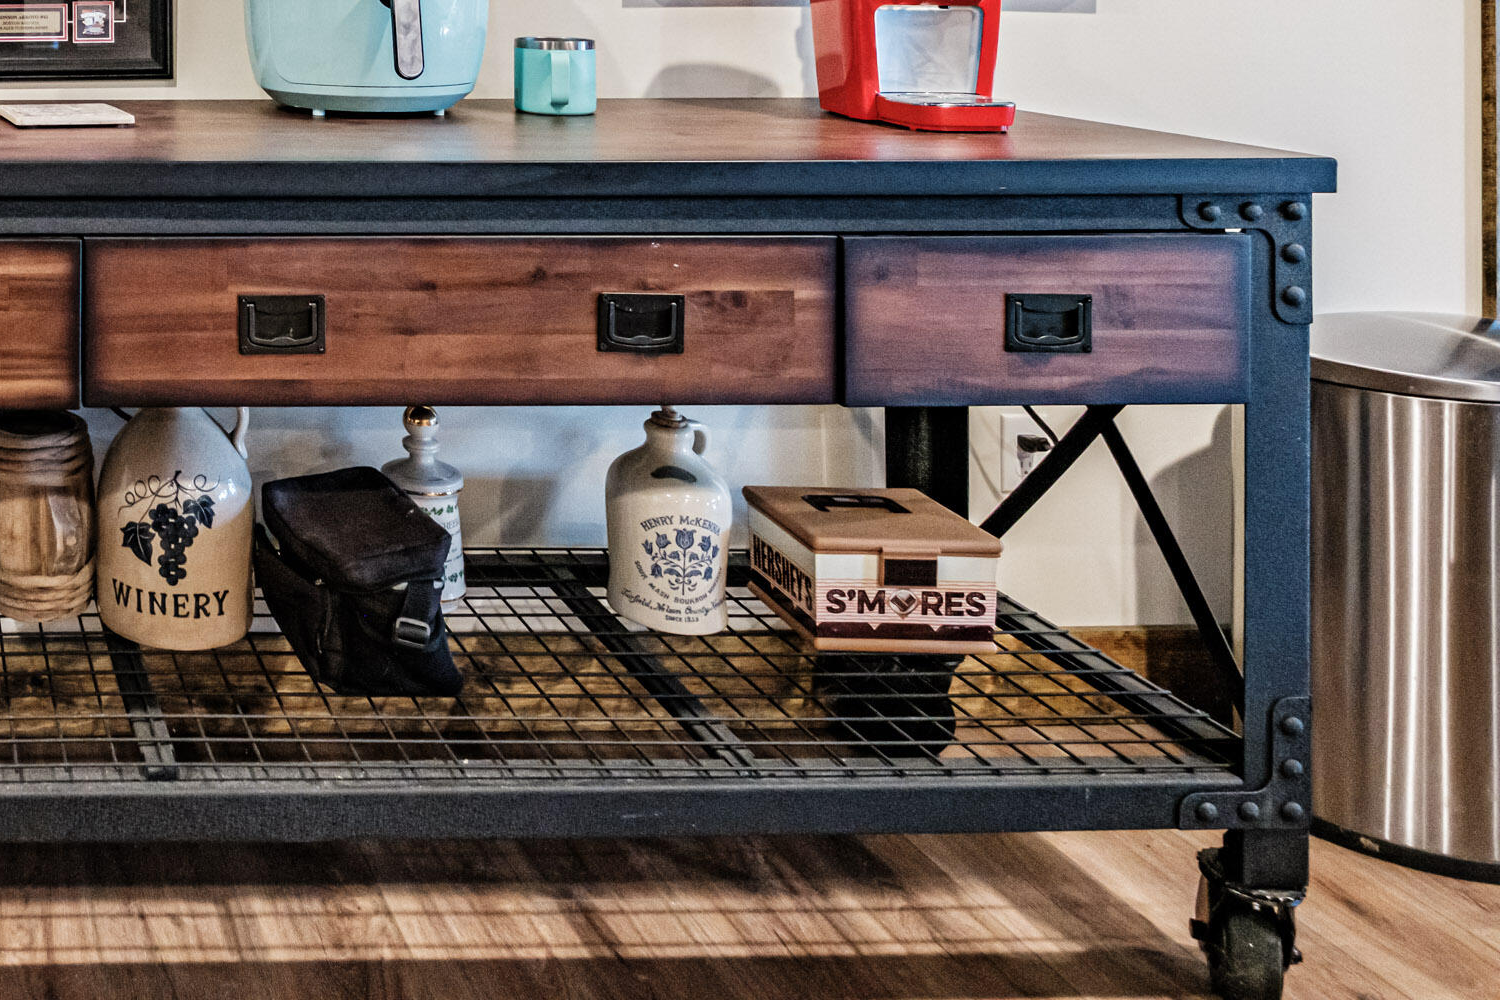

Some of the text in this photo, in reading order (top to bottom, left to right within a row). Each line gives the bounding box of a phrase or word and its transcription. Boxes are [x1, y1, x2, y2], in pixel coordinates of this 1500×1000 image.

[640, 515, 721, 536] HENRY McKENNA
[752, 532, 813, 612] HERSHEY'S
[112, 578, 230, 618] WINERY
[648, 583, 670, 599] MASH
[674, 593, 708, 605] BOURBON
